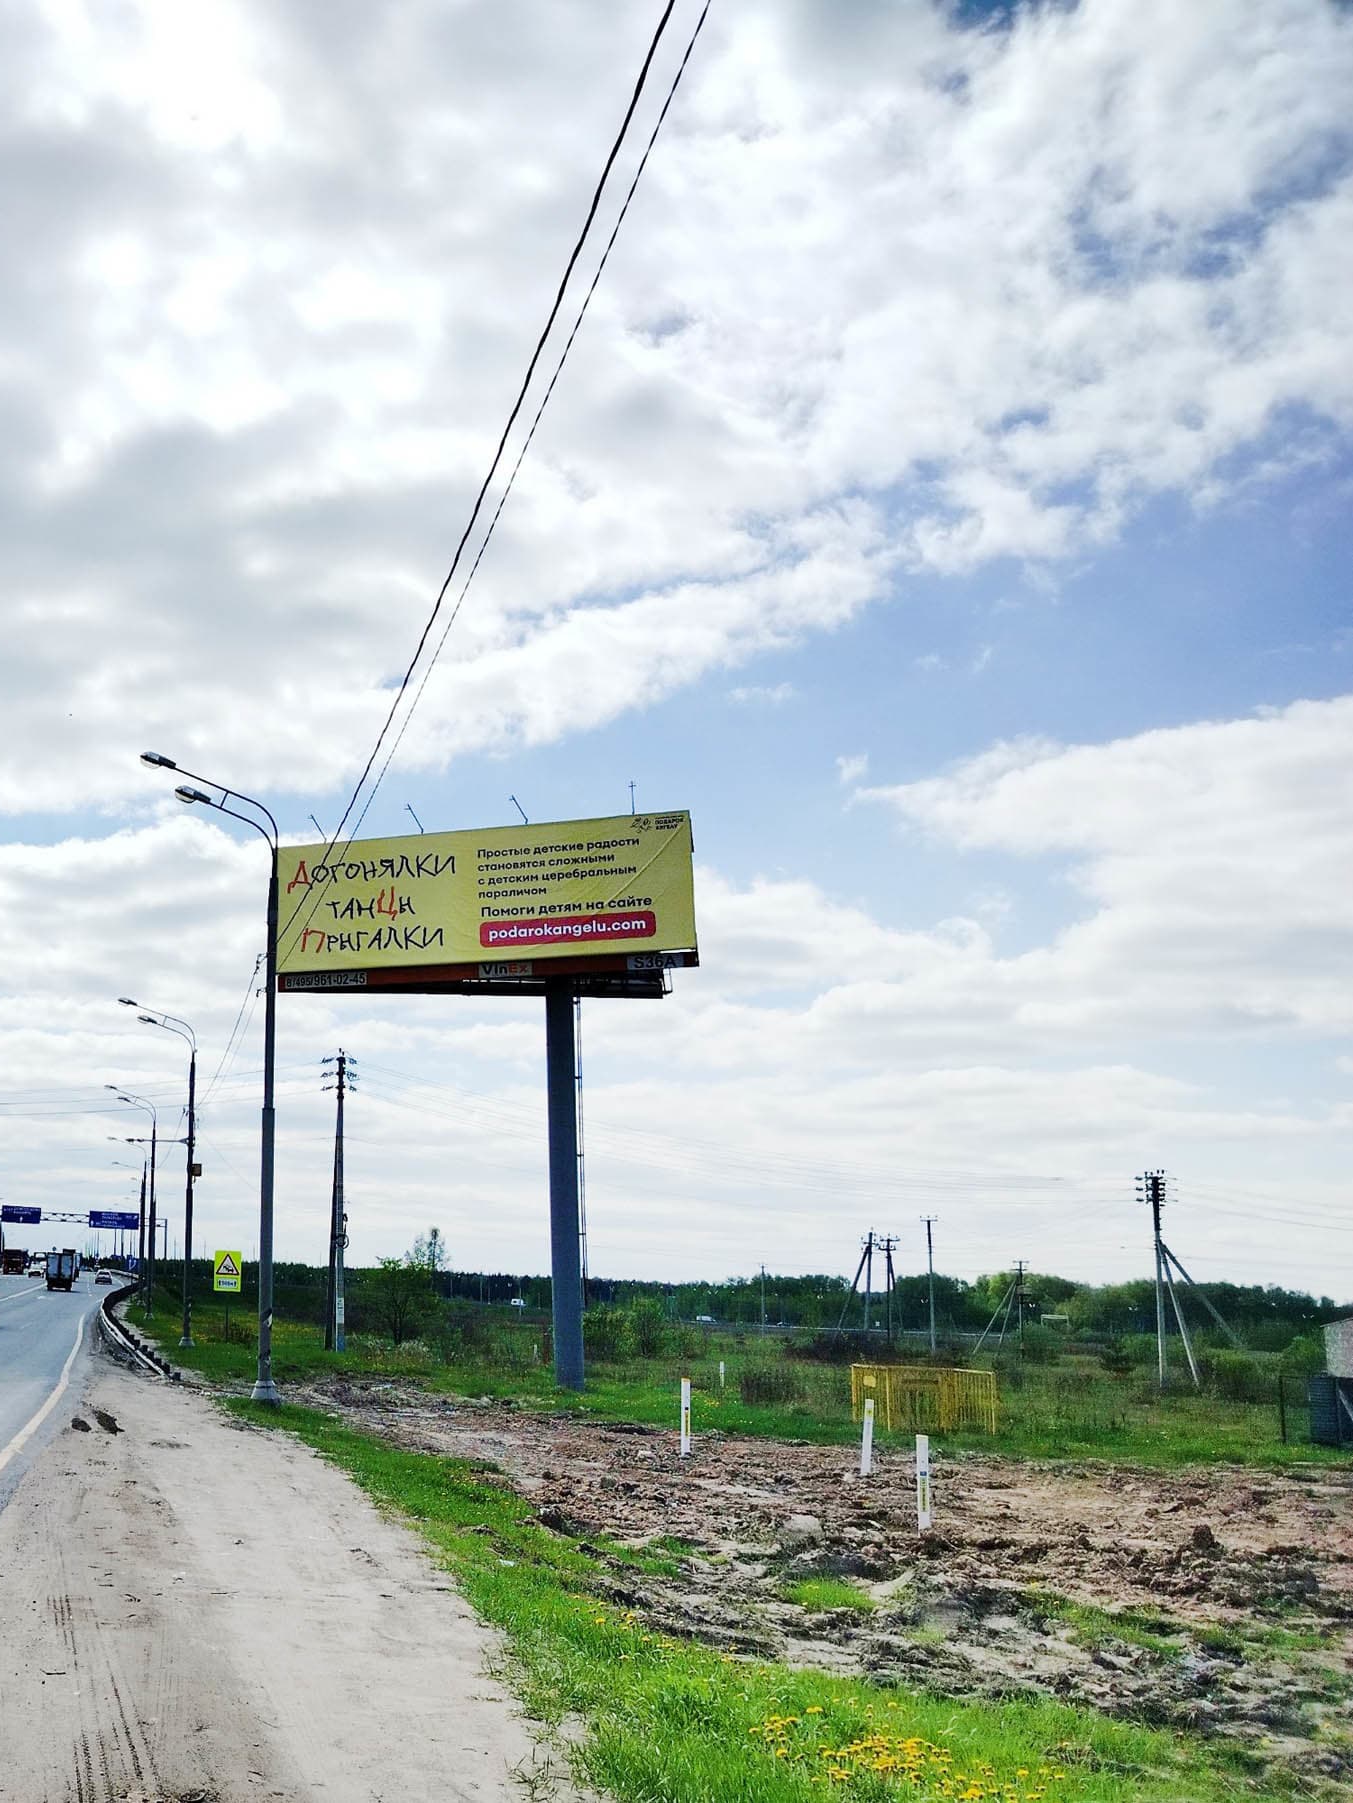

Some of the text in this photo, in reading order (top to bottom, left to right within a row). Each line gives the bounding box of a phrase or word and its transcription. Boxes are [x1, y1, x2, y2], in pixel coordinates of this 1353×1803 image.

[477, 837, 640, 859] Простые детские радости
[287, 853, 456, 894] ДОГОНЯЛКИ
[477, 854, 615, 872] становятся сложными
[478, 865, 637, 886] с детским церебральным
[478, 887, 547, 900] параличом
[481, 896, 652, 918] Помоги детям на сайте
[300, 926, 443, 953] ПРЫГАЛКИ
[489, 918, 646, 942] podarokangelu.com
[634, 955, 677, 969] S36A
